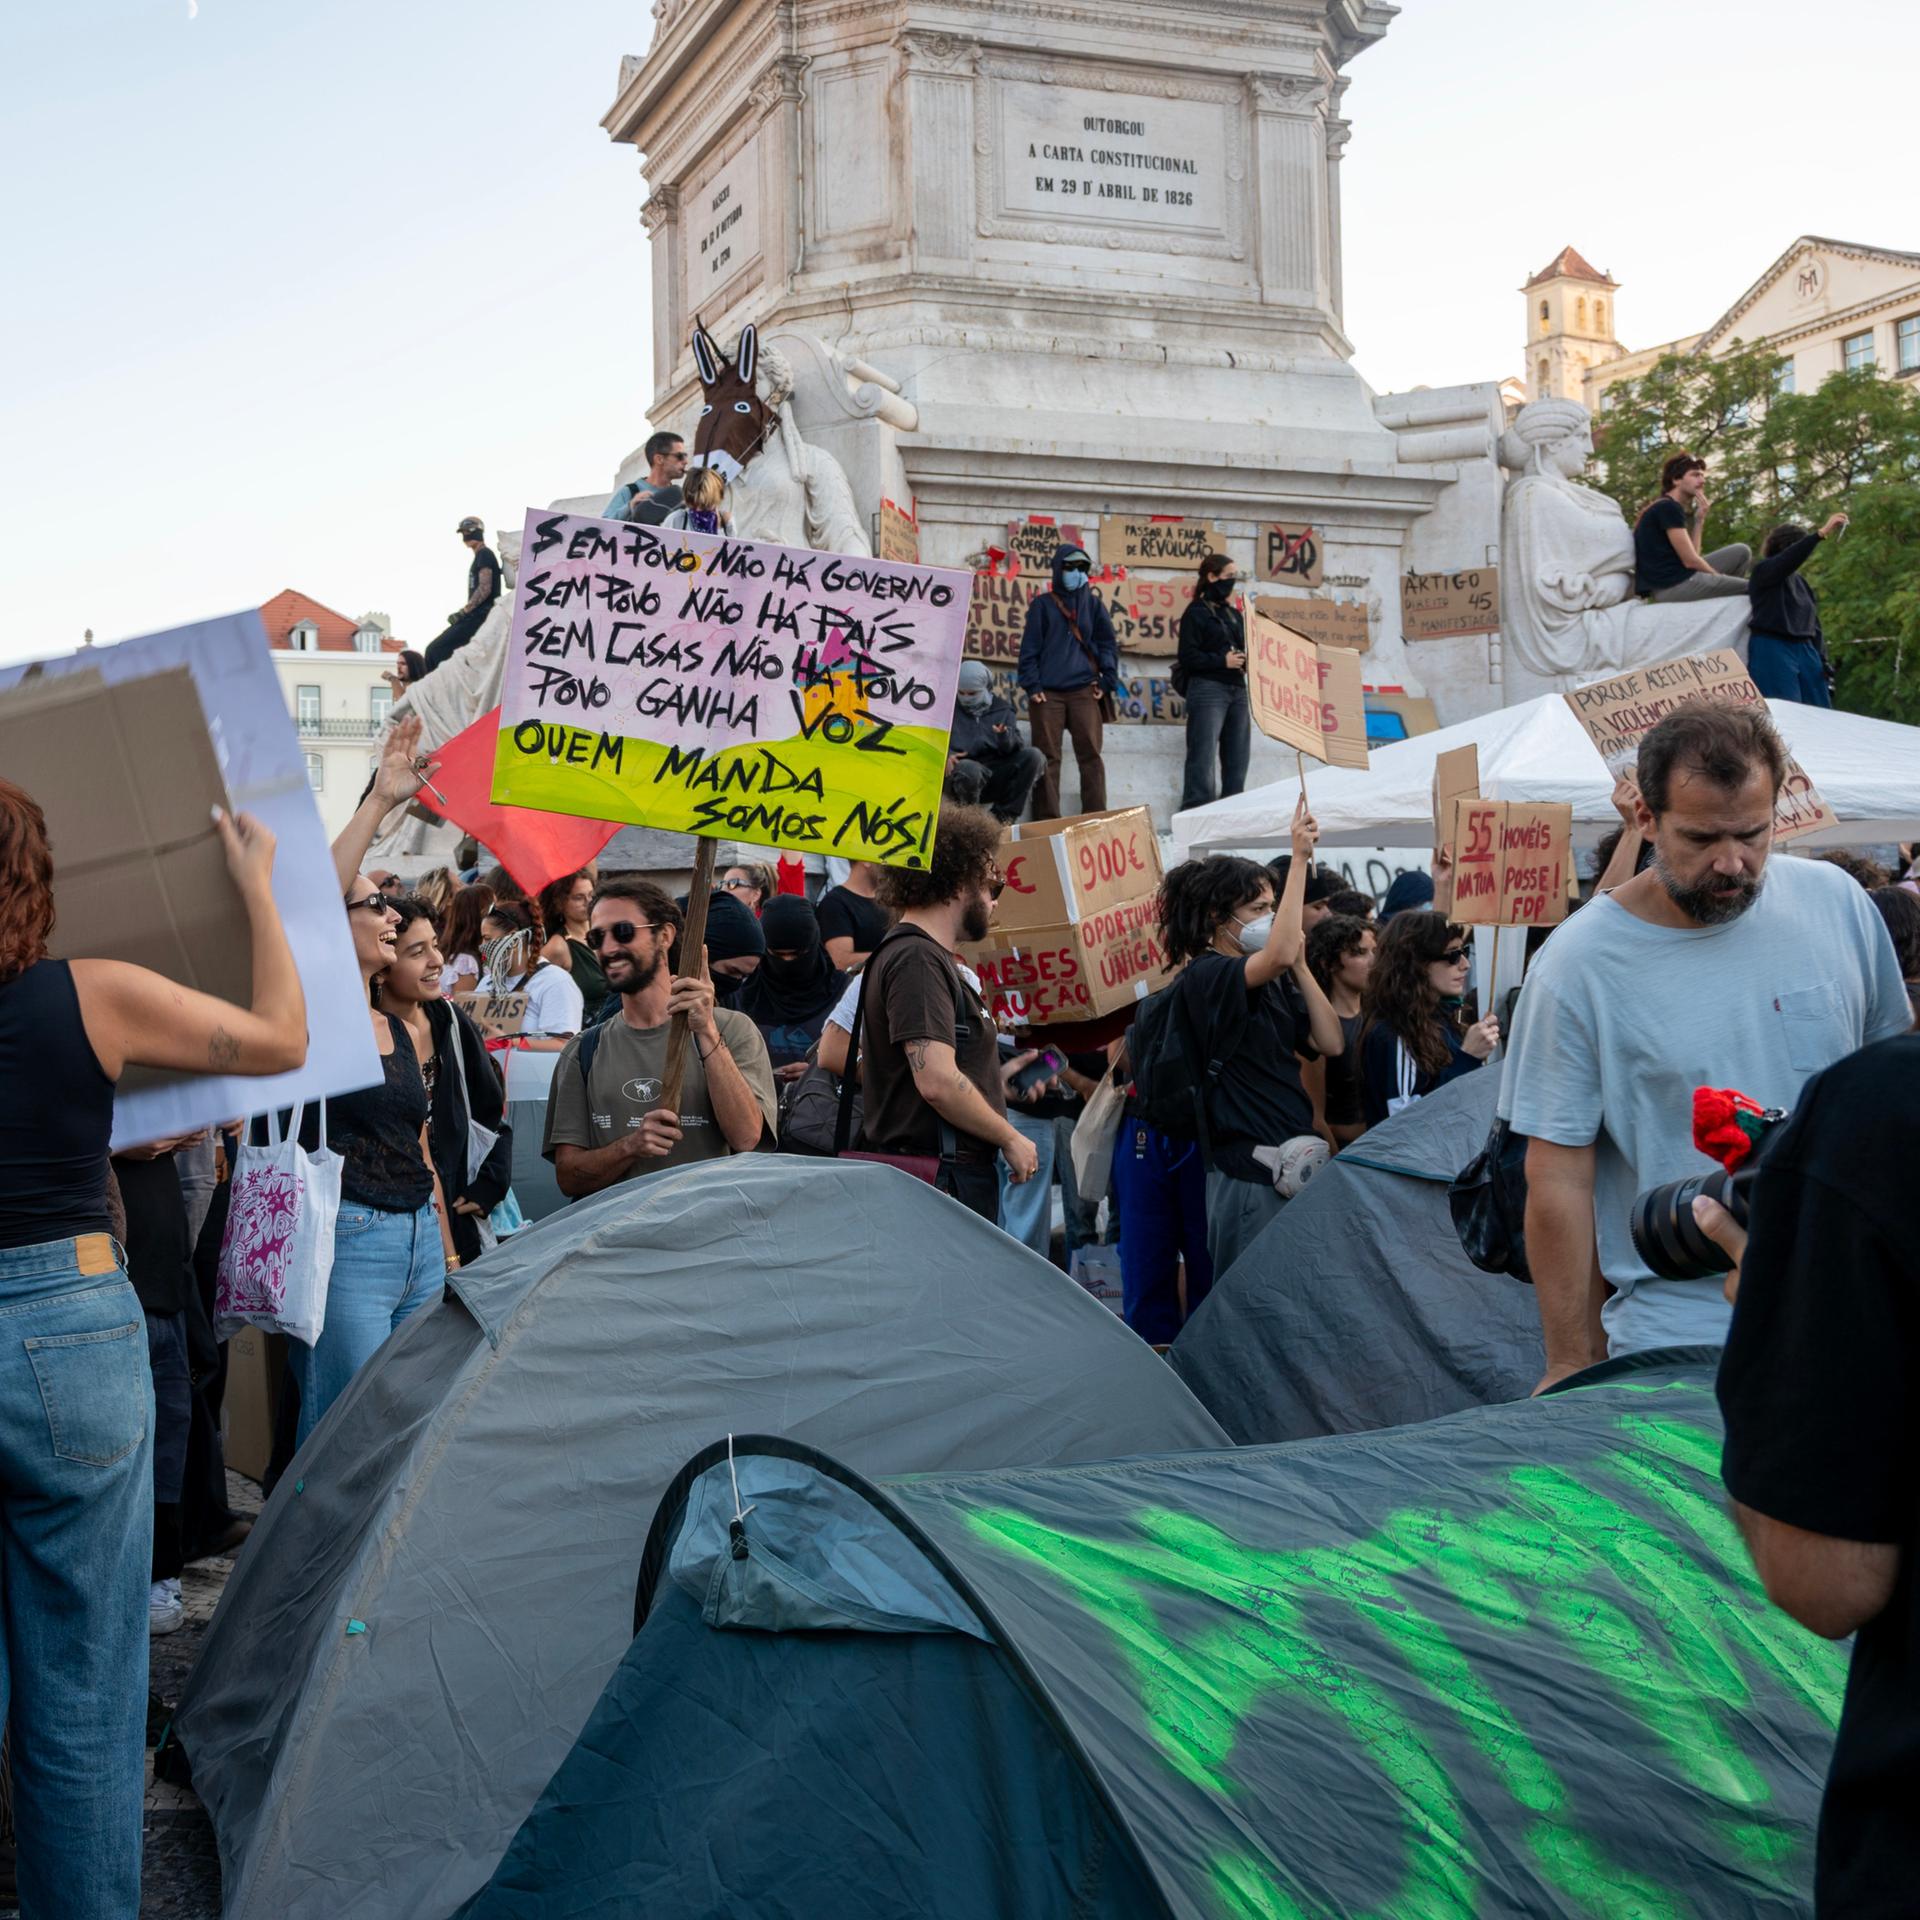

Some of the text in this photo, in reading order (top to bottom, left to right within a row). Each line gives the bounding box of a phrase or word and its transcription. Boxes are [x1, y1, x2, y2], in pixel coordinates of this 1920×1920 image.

[1084, 117, 1144, 136] OUTORGOU
[1028, 143, 1198, 175] A CARTA CONSTITUCIONAL
[1036, 177, 1054, 192] EM
[1061, 179, 1077, 194] 29
[1143, 187, 1158, 203] DE
[1165, 190, 1193, 206] 1826
[1021, 525, 1061, 541] AINDA
[1125, 525, 1162, 540] PASSAR
[1126, 545, 1137, 556] DE
[531, 515, 955, 608] SEM POVO NÃO HÁ GOVERNO
[524, 571, 915, 653] SEM POVO NÃO HÁ PAÍS
[1468, 592, 1492, 611] 45
[524, 617, 936, 711] SEM CASAS NÃO HÁ POVO
[527, 662, 907, 755] POVO GANHA VOZ
[1574, 675, 1642, 712] PORQUE
[1589, 719, 1607, 739] A
[514, 718, 825, 803] QUEM MANDA
[688, 797, 934, 868] SOMOS NÓS!
[1465, 811, 1496, 853] 55
[1080, 832, 1144, 891] 900€
[1512, 894, 1546, 923] FDP
[976, 948, 1078, 990] MESES
[983, 977, 1090, 1021] AUÇÃO
